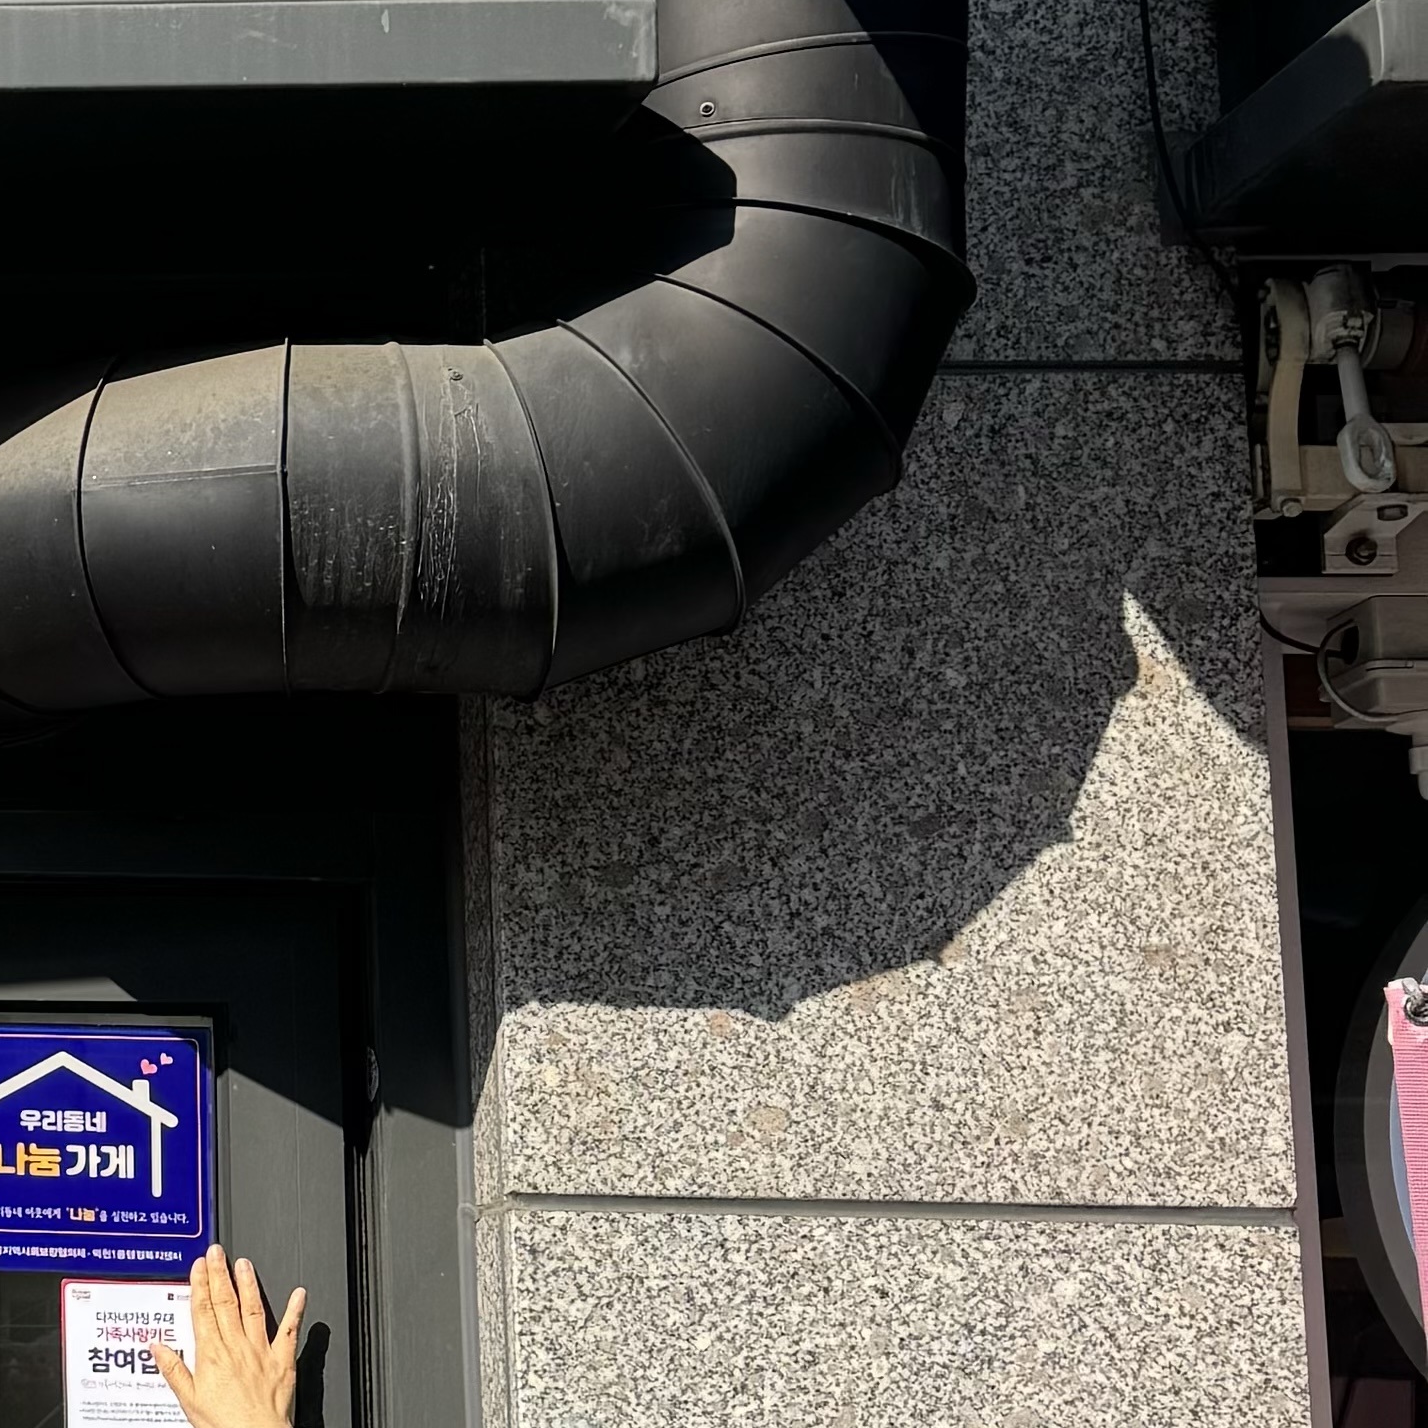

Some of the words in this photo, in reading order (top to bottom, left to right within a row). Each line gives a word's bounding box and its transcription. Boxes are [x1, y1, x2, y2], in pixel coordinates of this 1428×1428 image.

[20, 1109, 107, 1133] 우리동네
[65, 1143, 135, 1179] 가게
[96, 1311, 150, 1325] 다자녀가정
[153, 1312, 175, 1325] 우대
[96, 1327, 177, 1343] 가족사랑카드
[88, 1346, 184, 1375] 참여업
